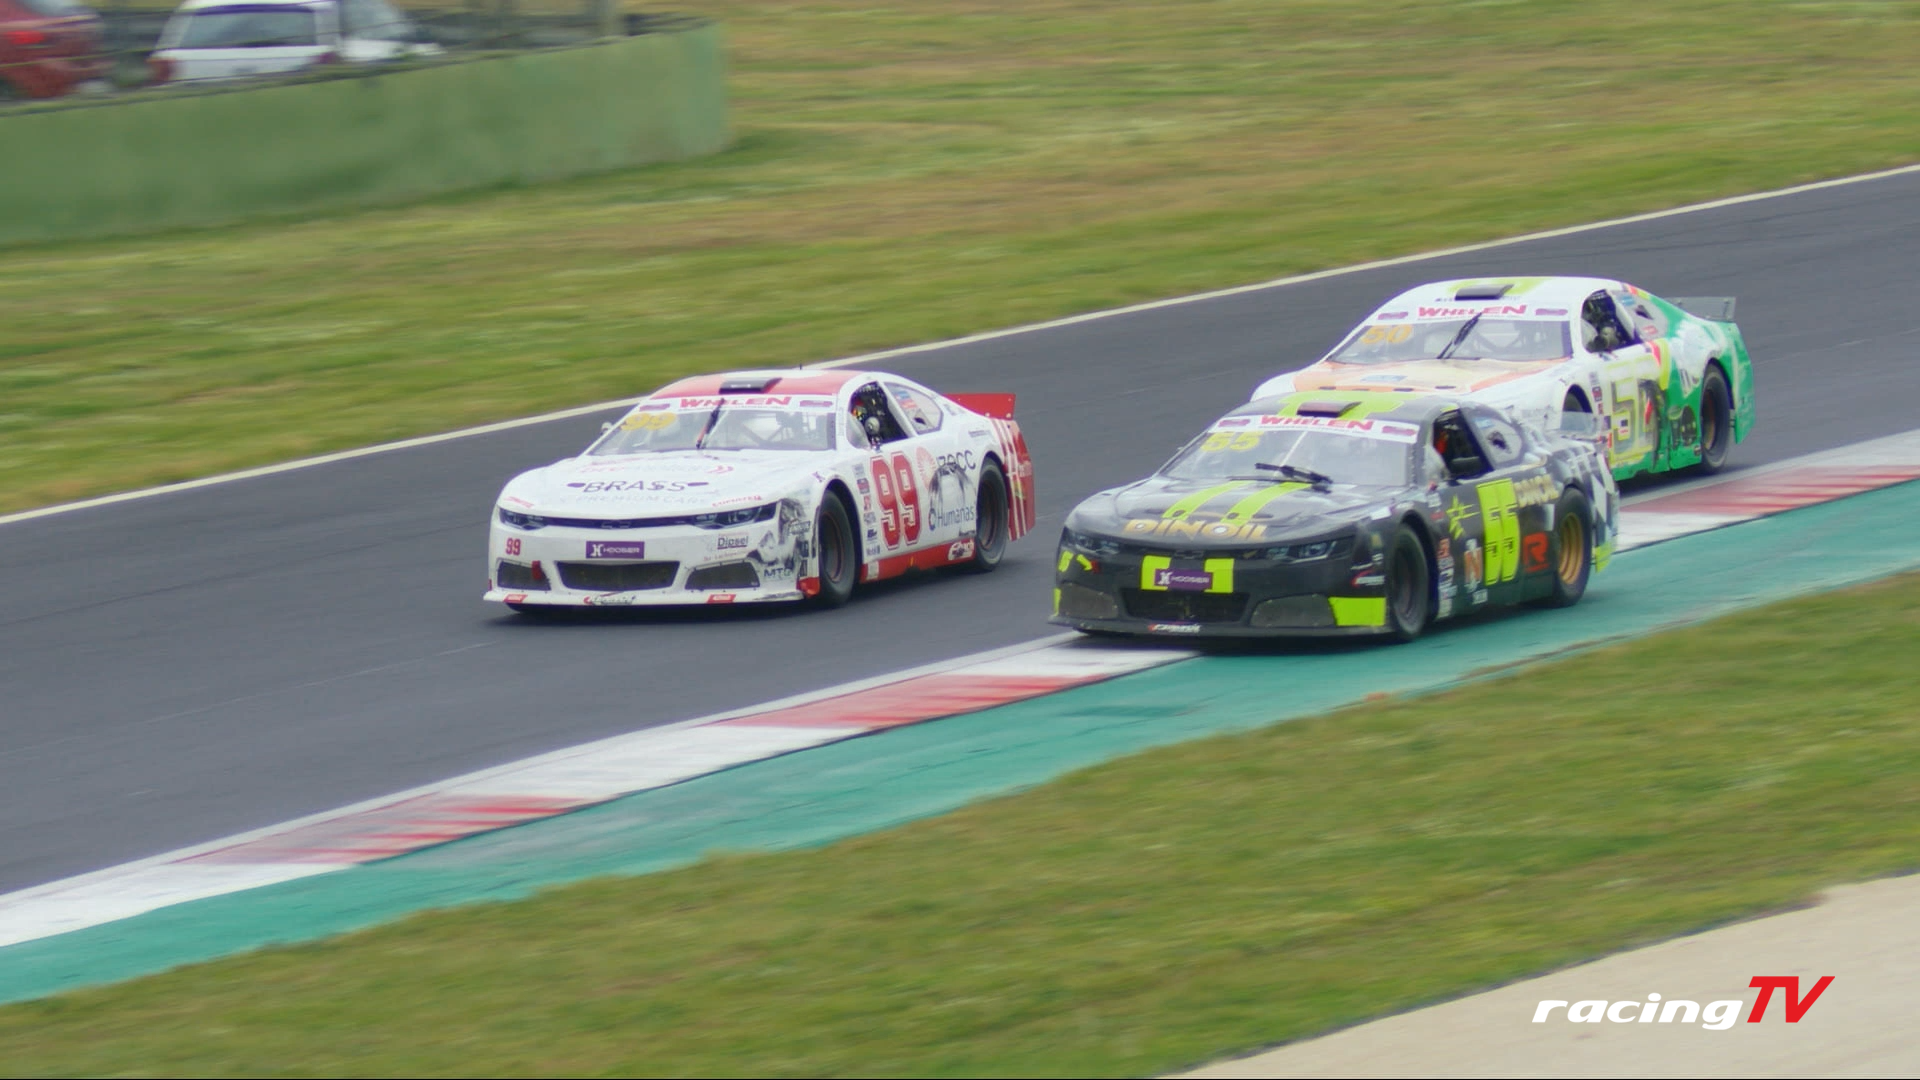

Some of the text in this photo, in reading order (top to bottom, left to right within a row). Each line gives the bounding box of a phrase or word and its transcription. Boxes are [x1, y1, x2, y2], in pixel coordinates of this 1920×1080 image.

[1418, 305, 1527, 317] WHELEN
[1360, 325, 1413, 344] 50
[680, 397, 792, 409] WHELEN
[620, 412, 676, 431] 99
[1261, 415, 1374, 431] WHELEN
[1202, 431, 1264, 451] 55
[583, 480, 687, 493] BRASS
[870, 450, 921, 551] 99
[935, 506, 975, 528] Humanas
[1476, 478, 1520, 587] 55
[505, 538, 521, 556] 99
